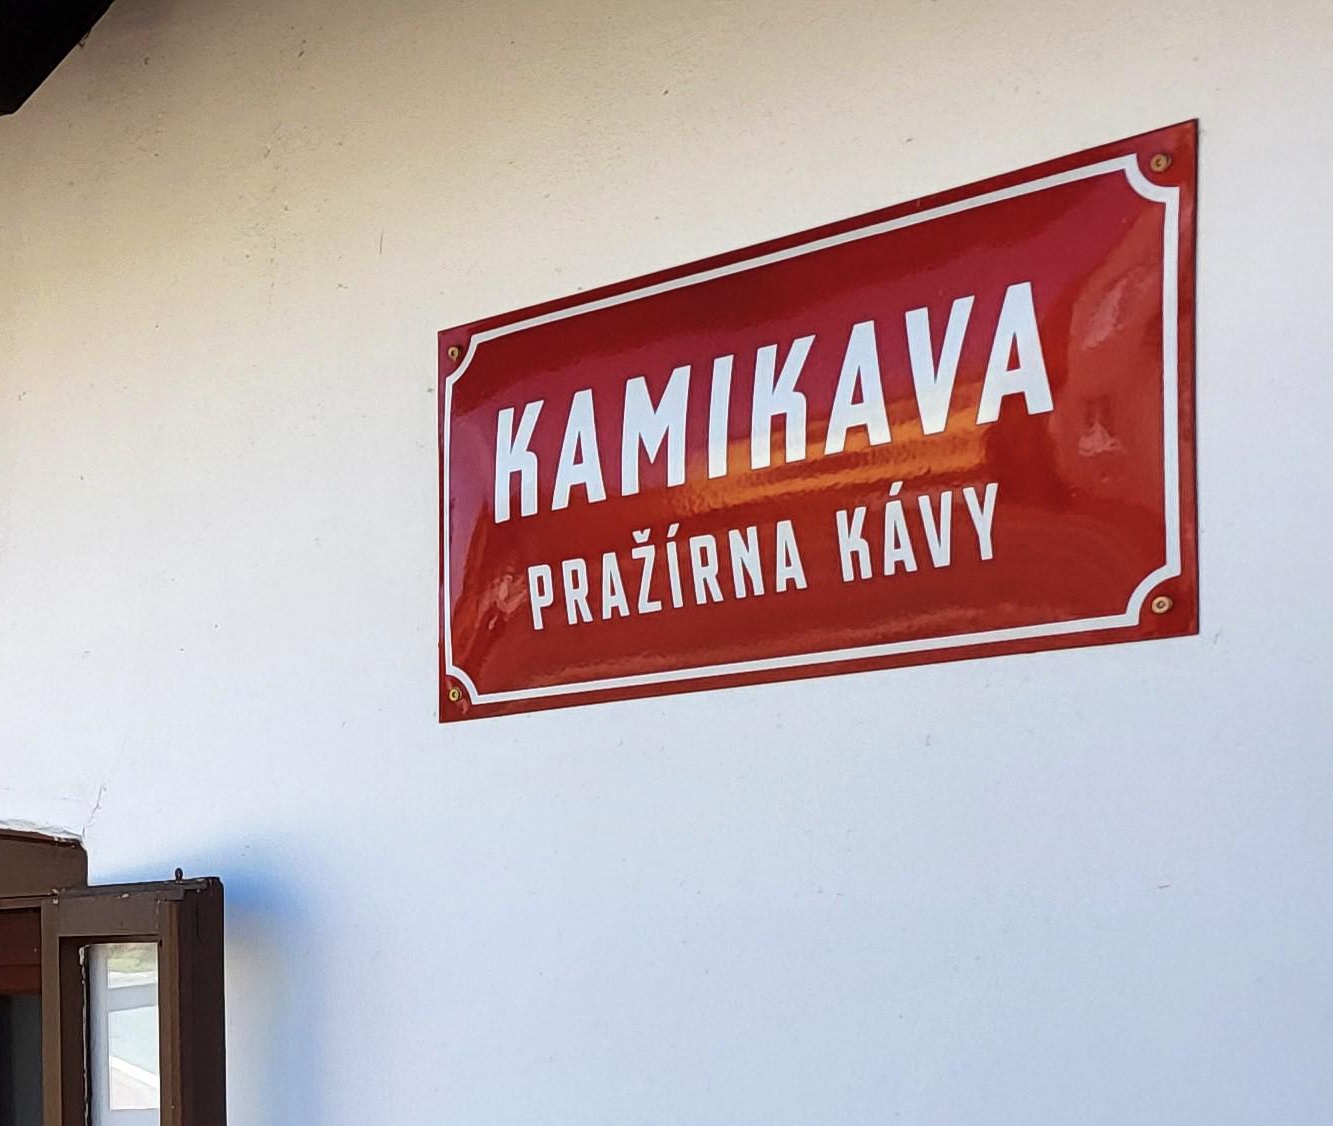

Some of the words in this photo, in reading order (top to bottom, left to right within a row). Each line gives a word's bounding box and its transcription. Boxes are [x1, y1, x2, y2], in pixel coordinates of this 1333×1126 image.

[494, 281, 1054, 524] KAMIKAVA
[526, 519, 808, 631] PRAŽÍRNA
[835, 482, 1000, 583] KÁVY
